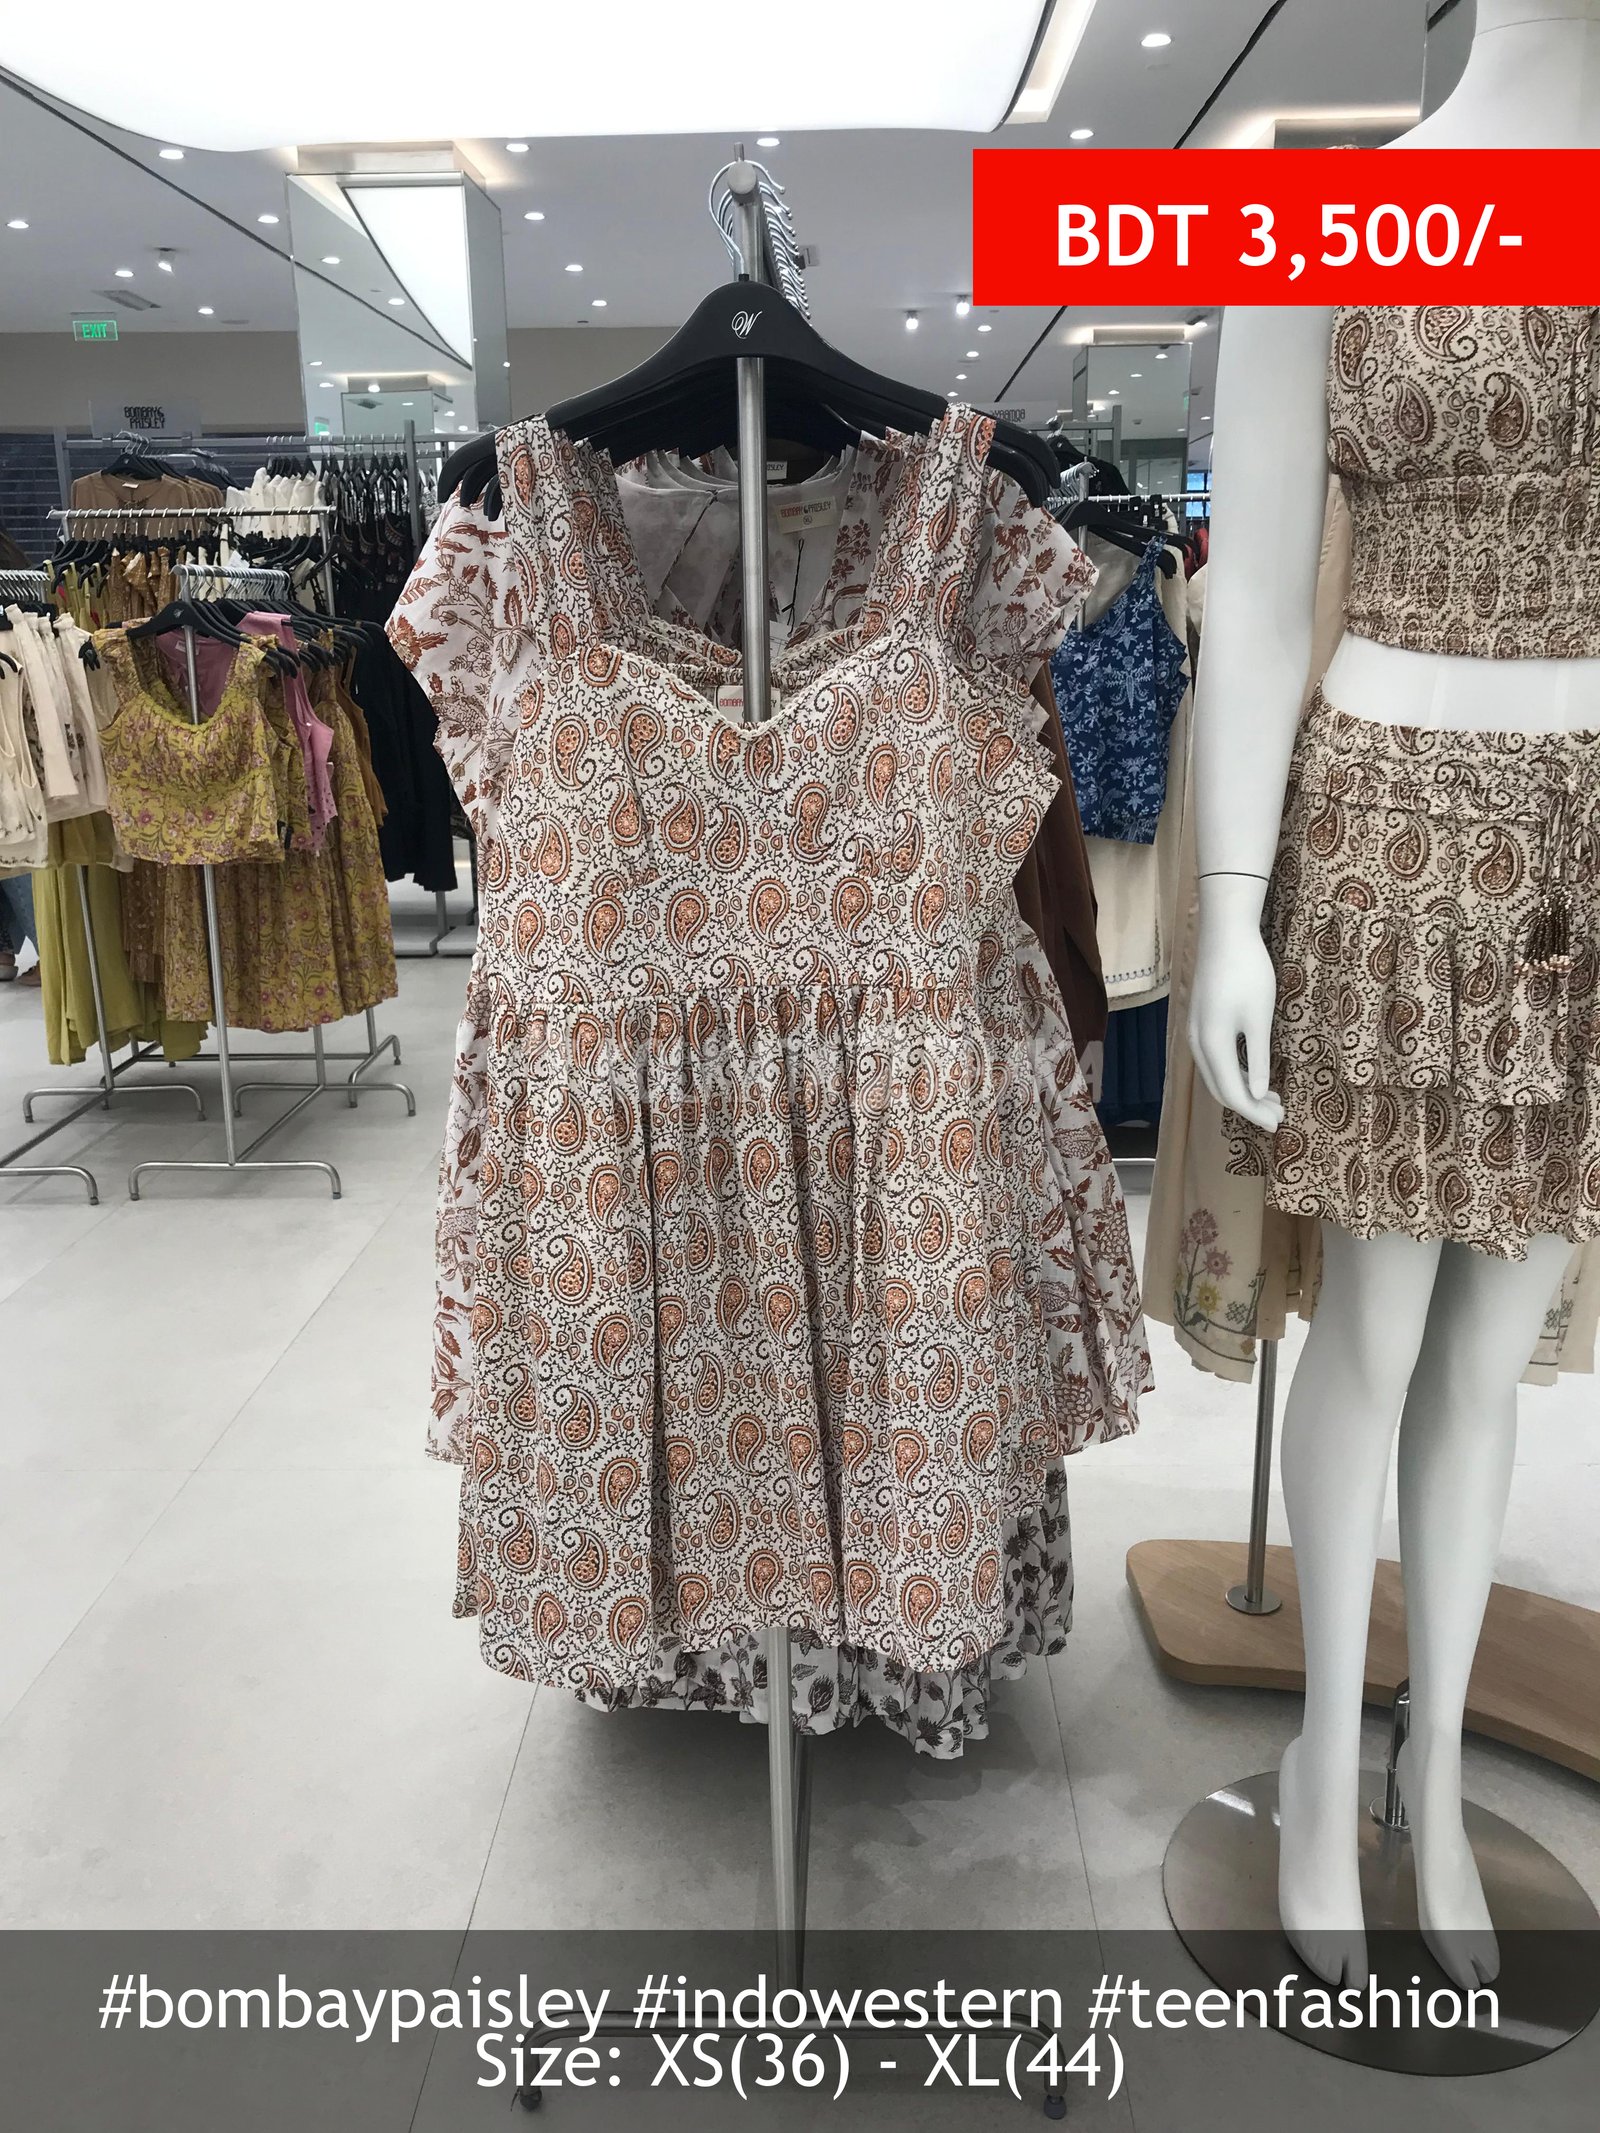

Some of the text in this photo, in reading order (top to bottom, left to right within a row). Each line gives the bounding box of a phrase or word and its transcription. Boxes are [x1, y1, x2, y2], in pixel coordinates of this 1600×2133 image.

[82, 323, 107, 338] EXIT
[130, 418, 165, 429] PAISLEY
[807, 502, 831, 513] PAISLEY
